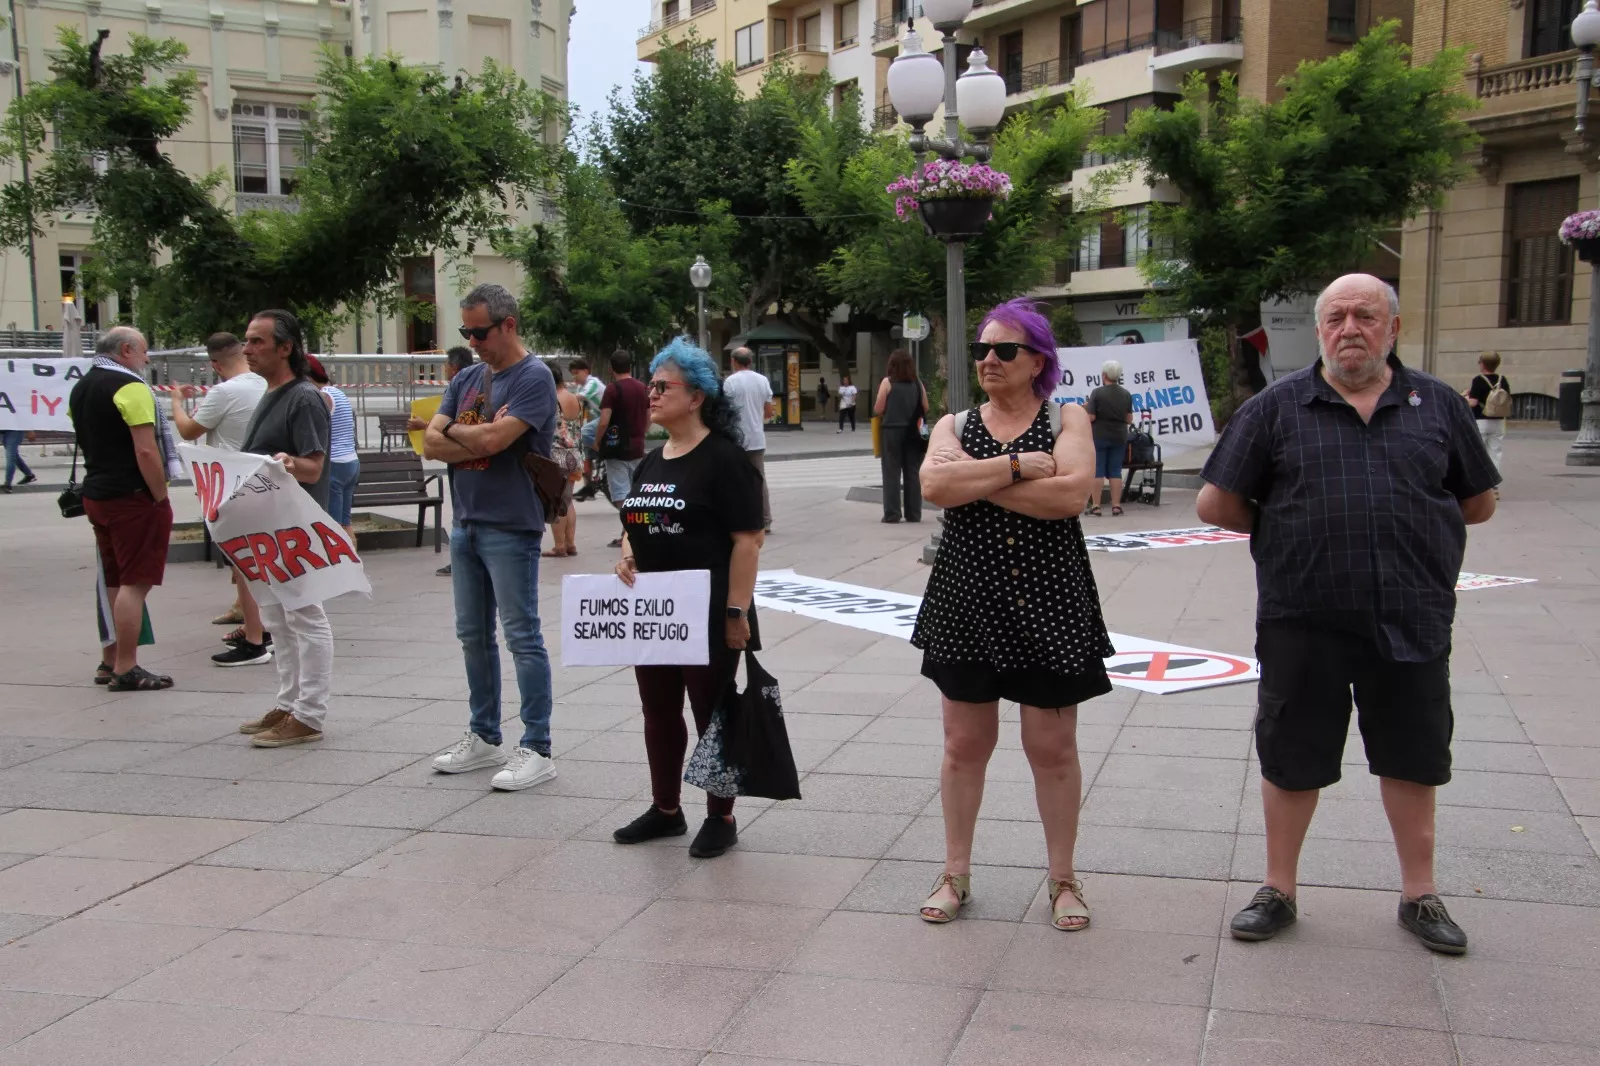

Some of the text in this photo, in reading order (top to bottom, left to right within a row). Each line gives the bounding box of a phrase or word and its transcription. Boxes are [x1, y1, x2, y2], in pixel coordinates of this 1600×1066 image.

[1086, 373, 1125, 387] PUE
[1134, 370, 1155, 385] SER
[1165, 369, 1180, 381] EL
[192, 461, 225, 523] NO
[640, 483, 676, 493] TRANS
[622, 496, 686, 510] FORMANDO
[627, 511, 670, 524] HUESCA
[217, 521, 361, 585] ERRA
[580, 598, 674, 616] FUIMOS EXILIO
[574, 622, 689, 641] SEAMOS REFUGIO
